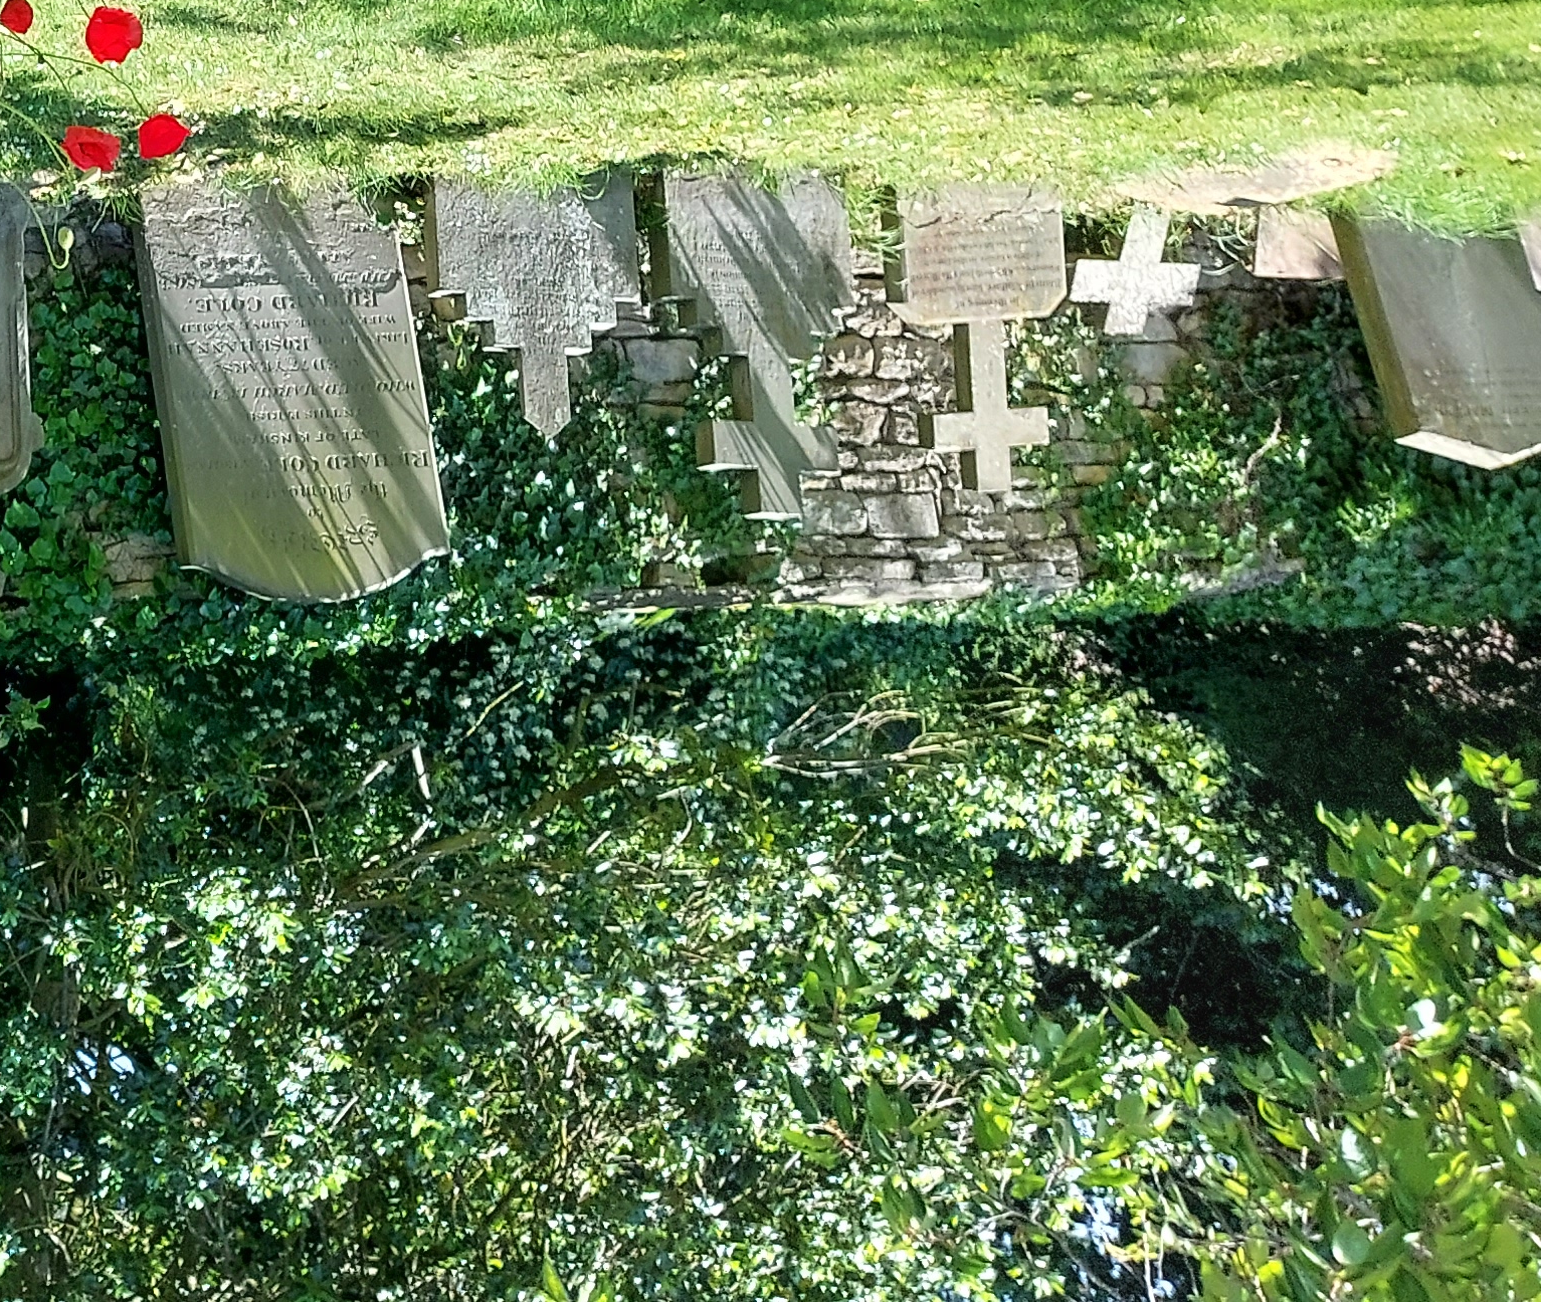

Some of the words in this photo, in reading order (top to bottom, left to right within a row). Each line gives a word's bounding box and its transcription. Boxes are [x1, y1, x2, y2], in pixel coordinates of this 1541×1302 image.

[271, 289, 380, 312] RICHARD
[242, 317, 292, 332] ABOVE
[357, 313, 397, 326] WIFE
[179, 320, 236, 335] NAMED
[253, 383, 321, 399] MARCH
[375, 379, 416, 393] WHO
[244, 409, 301, 422] PARISH
[304, 409, 343, 421] THIS
[315, 432, 334, 443] OF
[324, 450, 429, 471] RICHARD
[359, 480, 388, 500] the
